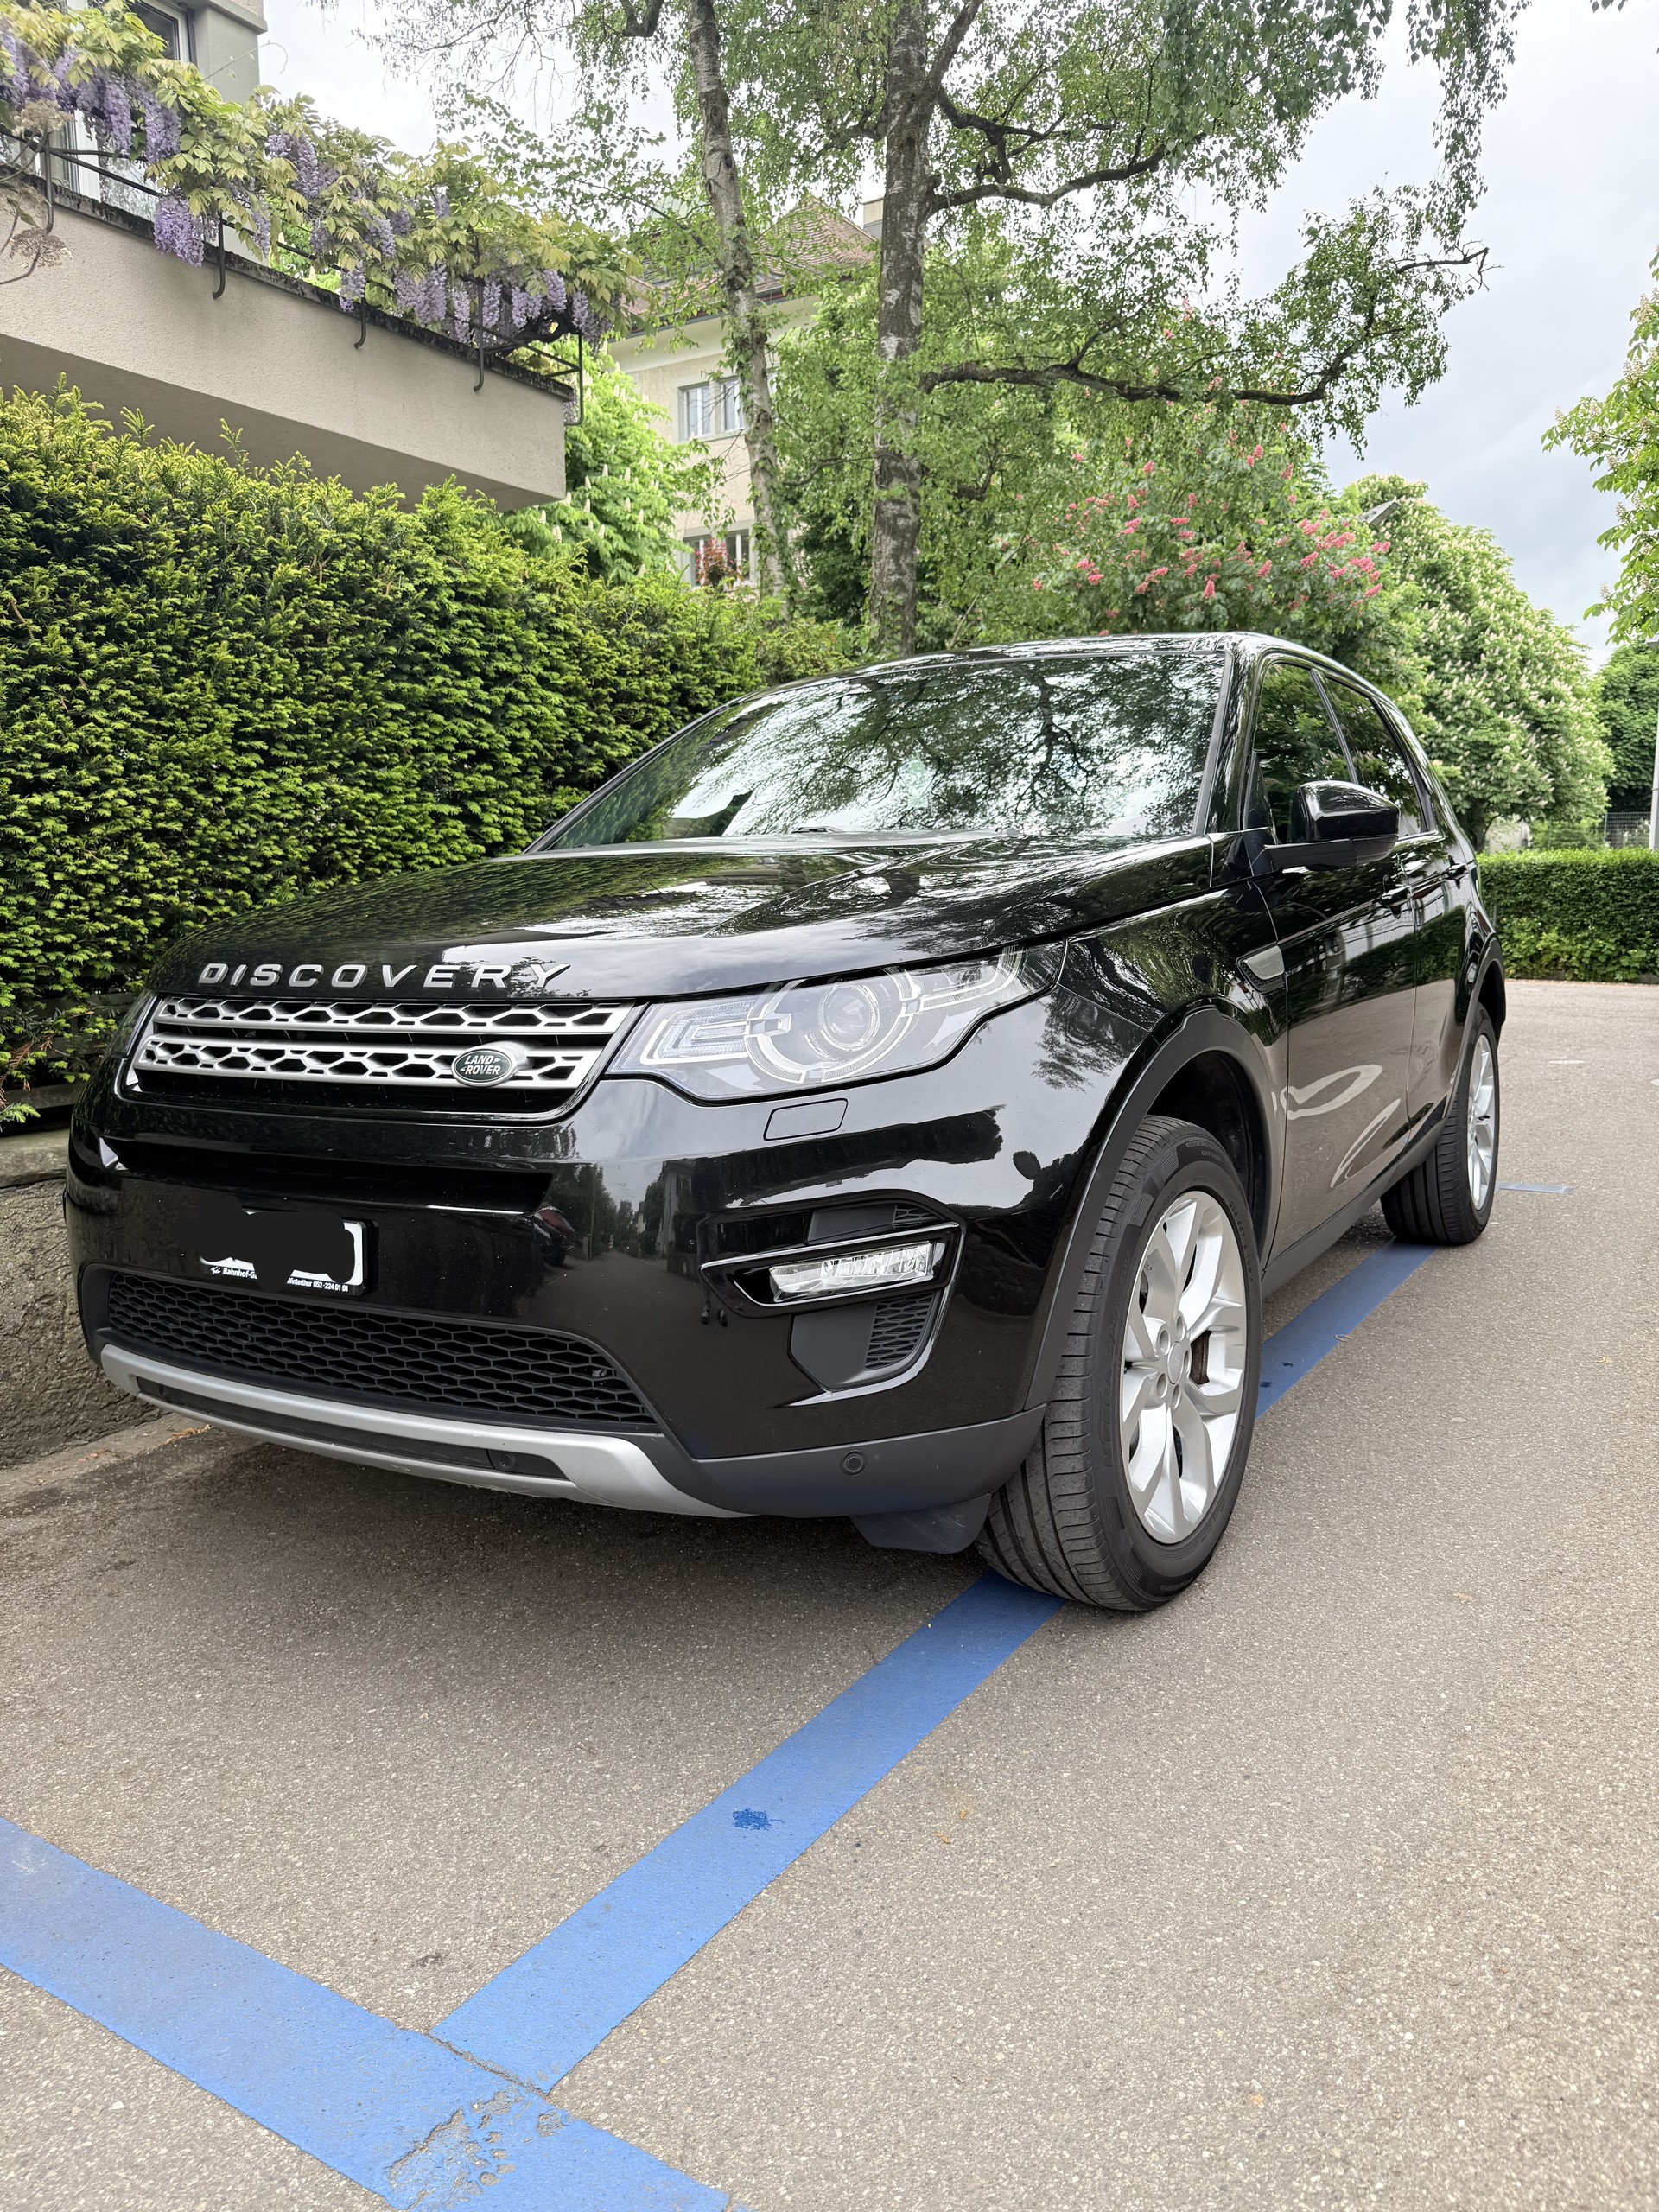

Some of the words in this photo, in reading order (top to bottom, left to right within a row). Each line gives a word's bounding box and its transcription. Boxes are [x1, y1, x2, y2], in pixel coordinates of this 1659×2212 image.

[198, 962, 571, 988] DISCOVERY
[465, 1055, 493, 1065] LAND
[465, 1065, 501, 1075] ROVER
